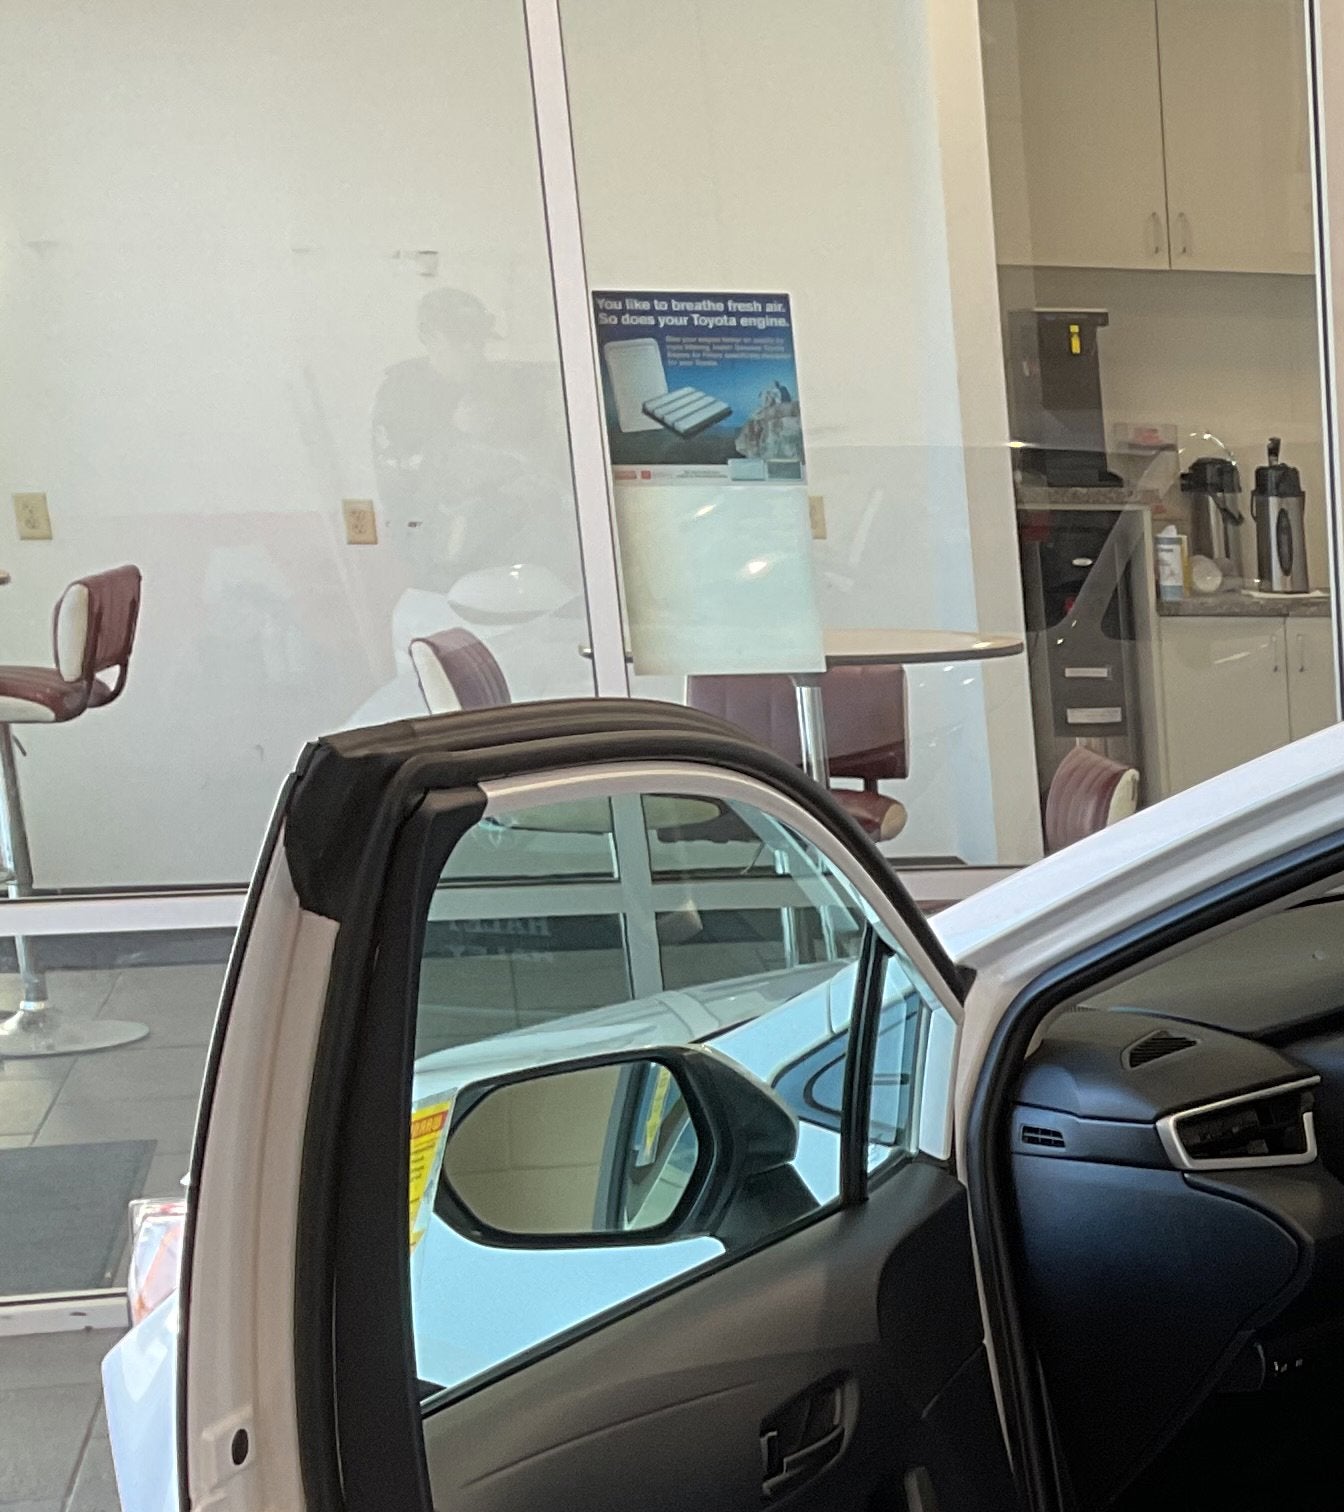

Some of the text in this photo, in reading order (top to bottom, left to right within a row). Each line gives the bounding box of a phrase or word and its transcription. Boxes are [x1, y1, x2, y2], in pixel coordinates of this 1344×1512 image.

[596, 298, 786, 312] You like to breathe fresh air.
[598, 312, 789, 329] So does your Toyota engine.
